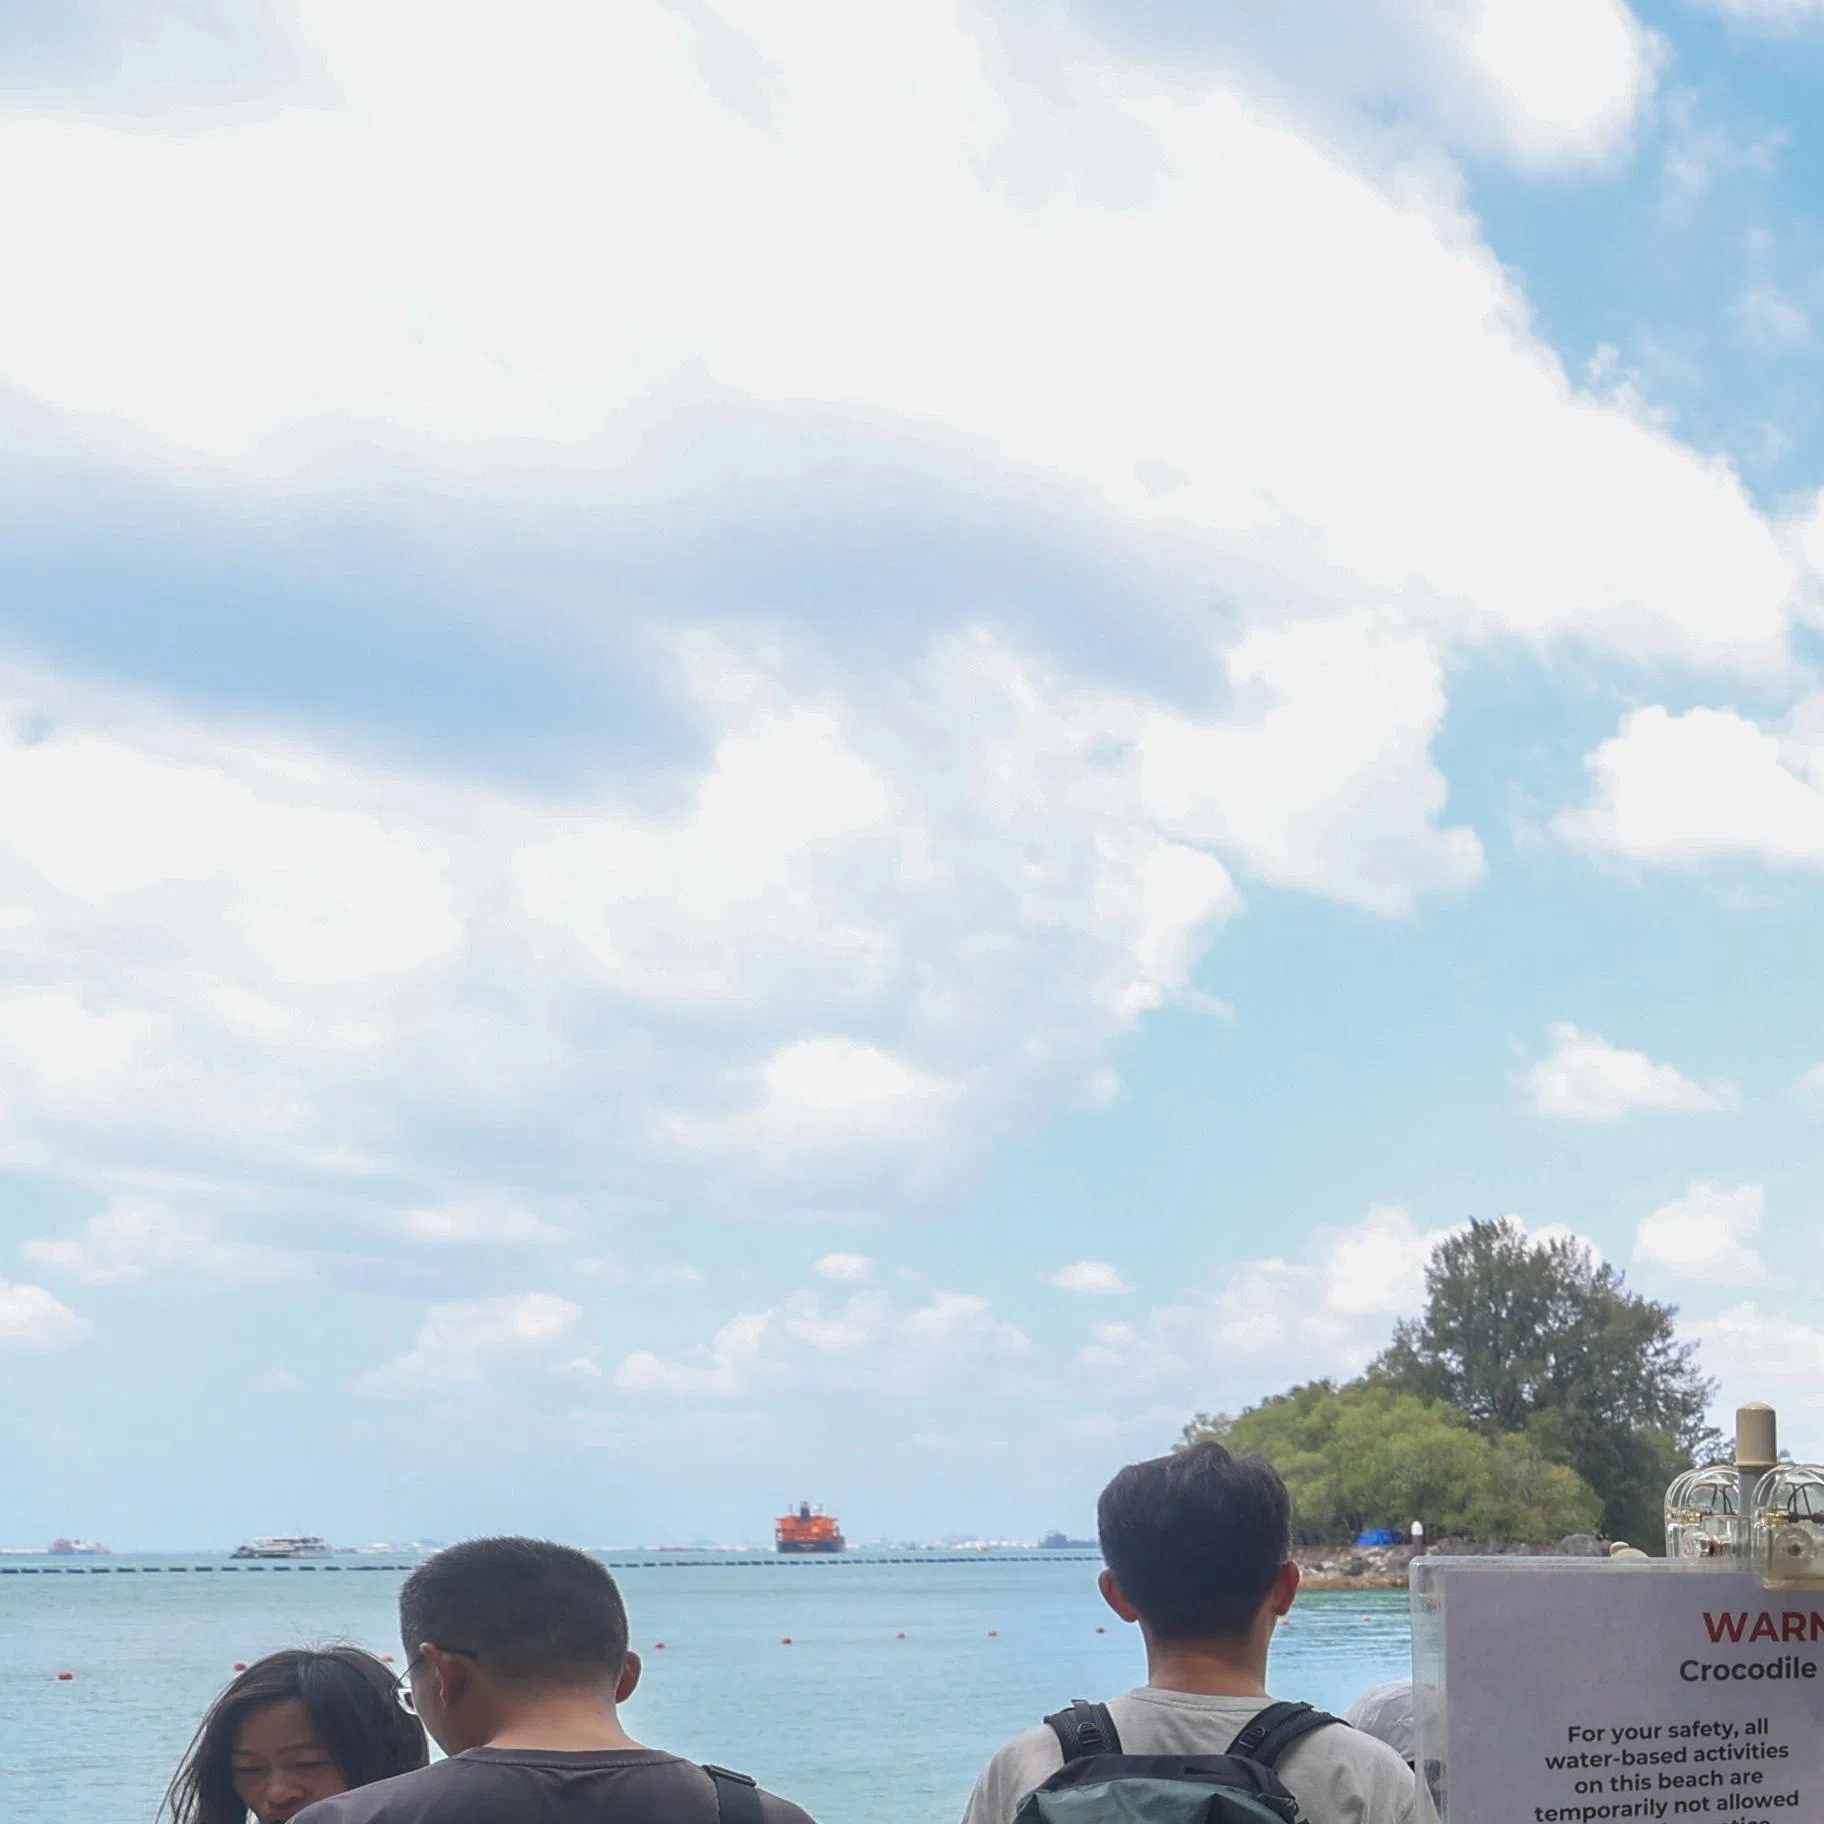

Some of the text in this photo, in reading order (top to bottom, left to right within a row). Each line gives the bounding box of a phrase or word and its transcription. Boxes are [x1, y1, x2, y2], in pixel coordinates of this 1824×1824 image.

[1680, 1656, 1817, 1682] Crocodile
[1568, 1718, 1768, 1745] For your safety, all
[1545, 1742, 1789, 1770] water-based activities
[1574, 1770, 1763, 1794] on this beach are
[1534, 1789, 1799, 1824] temporarily not allowed
